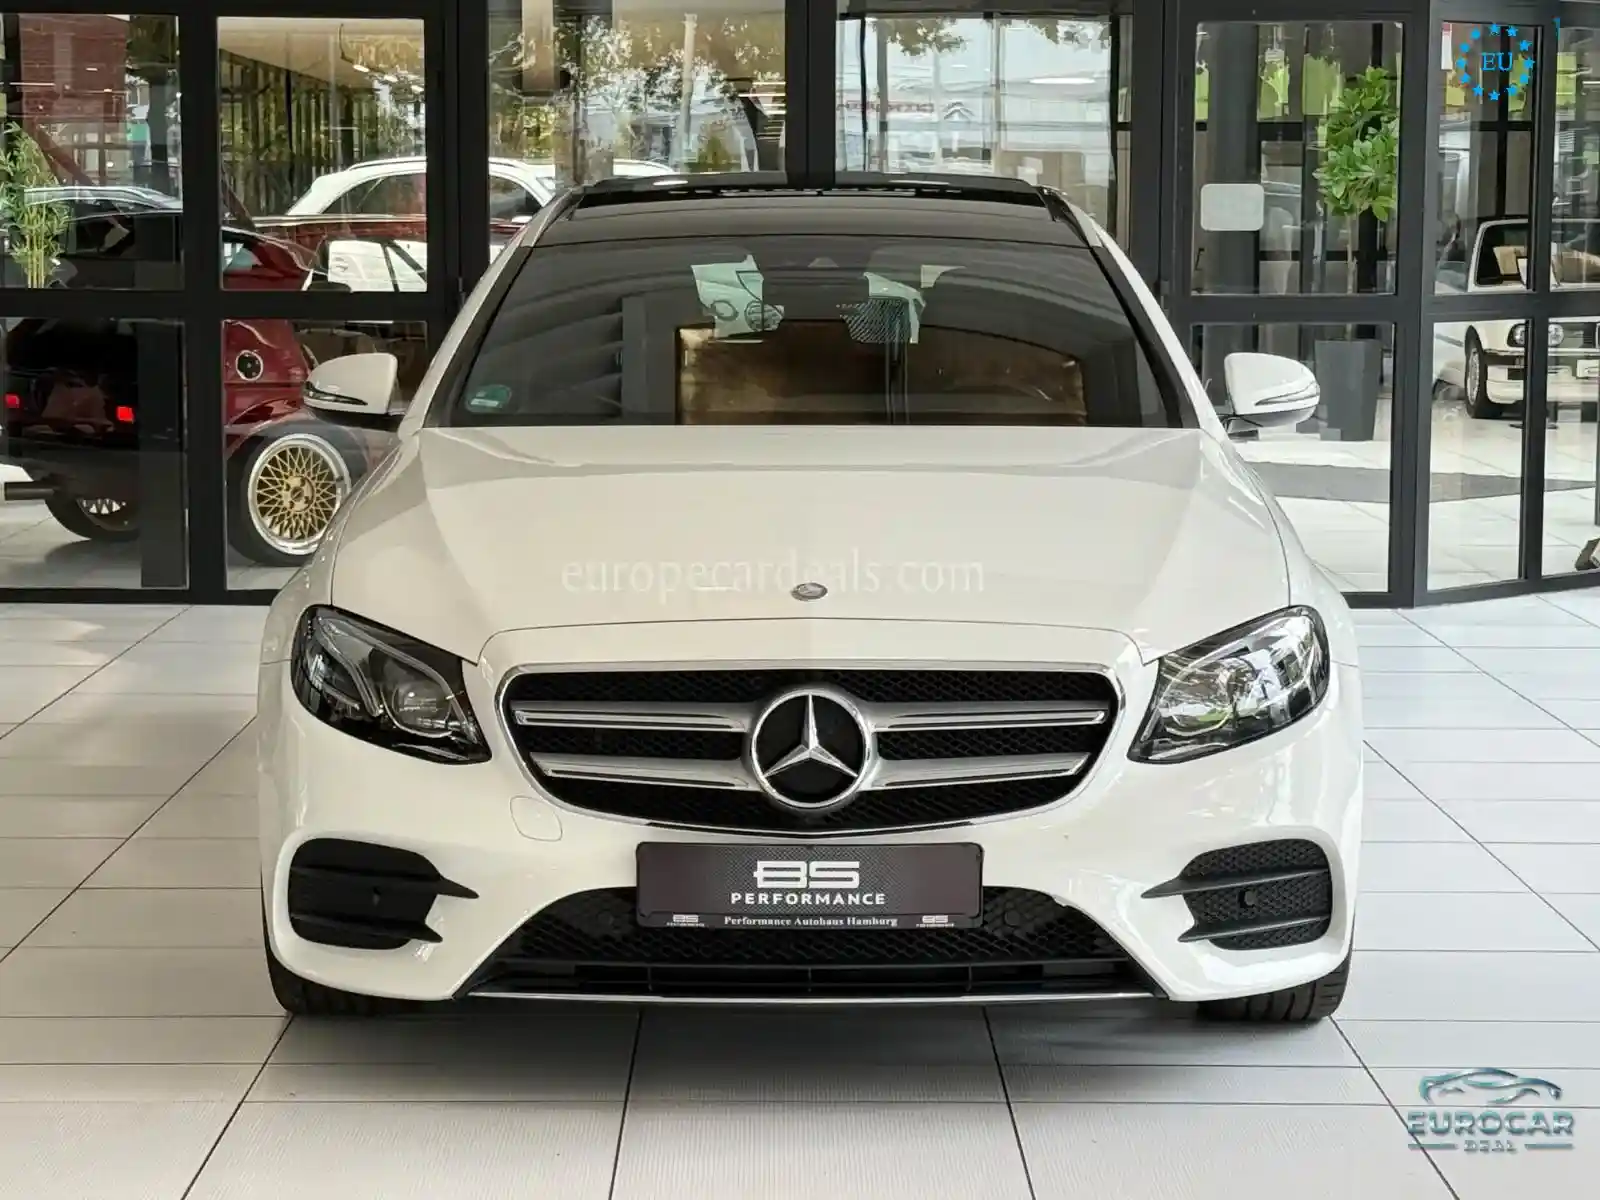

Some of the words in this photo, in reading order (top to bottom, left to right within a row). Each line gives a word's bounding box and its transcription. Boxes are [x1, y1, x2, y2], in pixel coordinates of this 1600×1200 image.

[730, 892, 886, 905] PERFORMANCE
[724, 915, 792, 926] Performance
[794, 916, 844, 926] Autohaus
[847, 915, 899, 928] Hamburg
